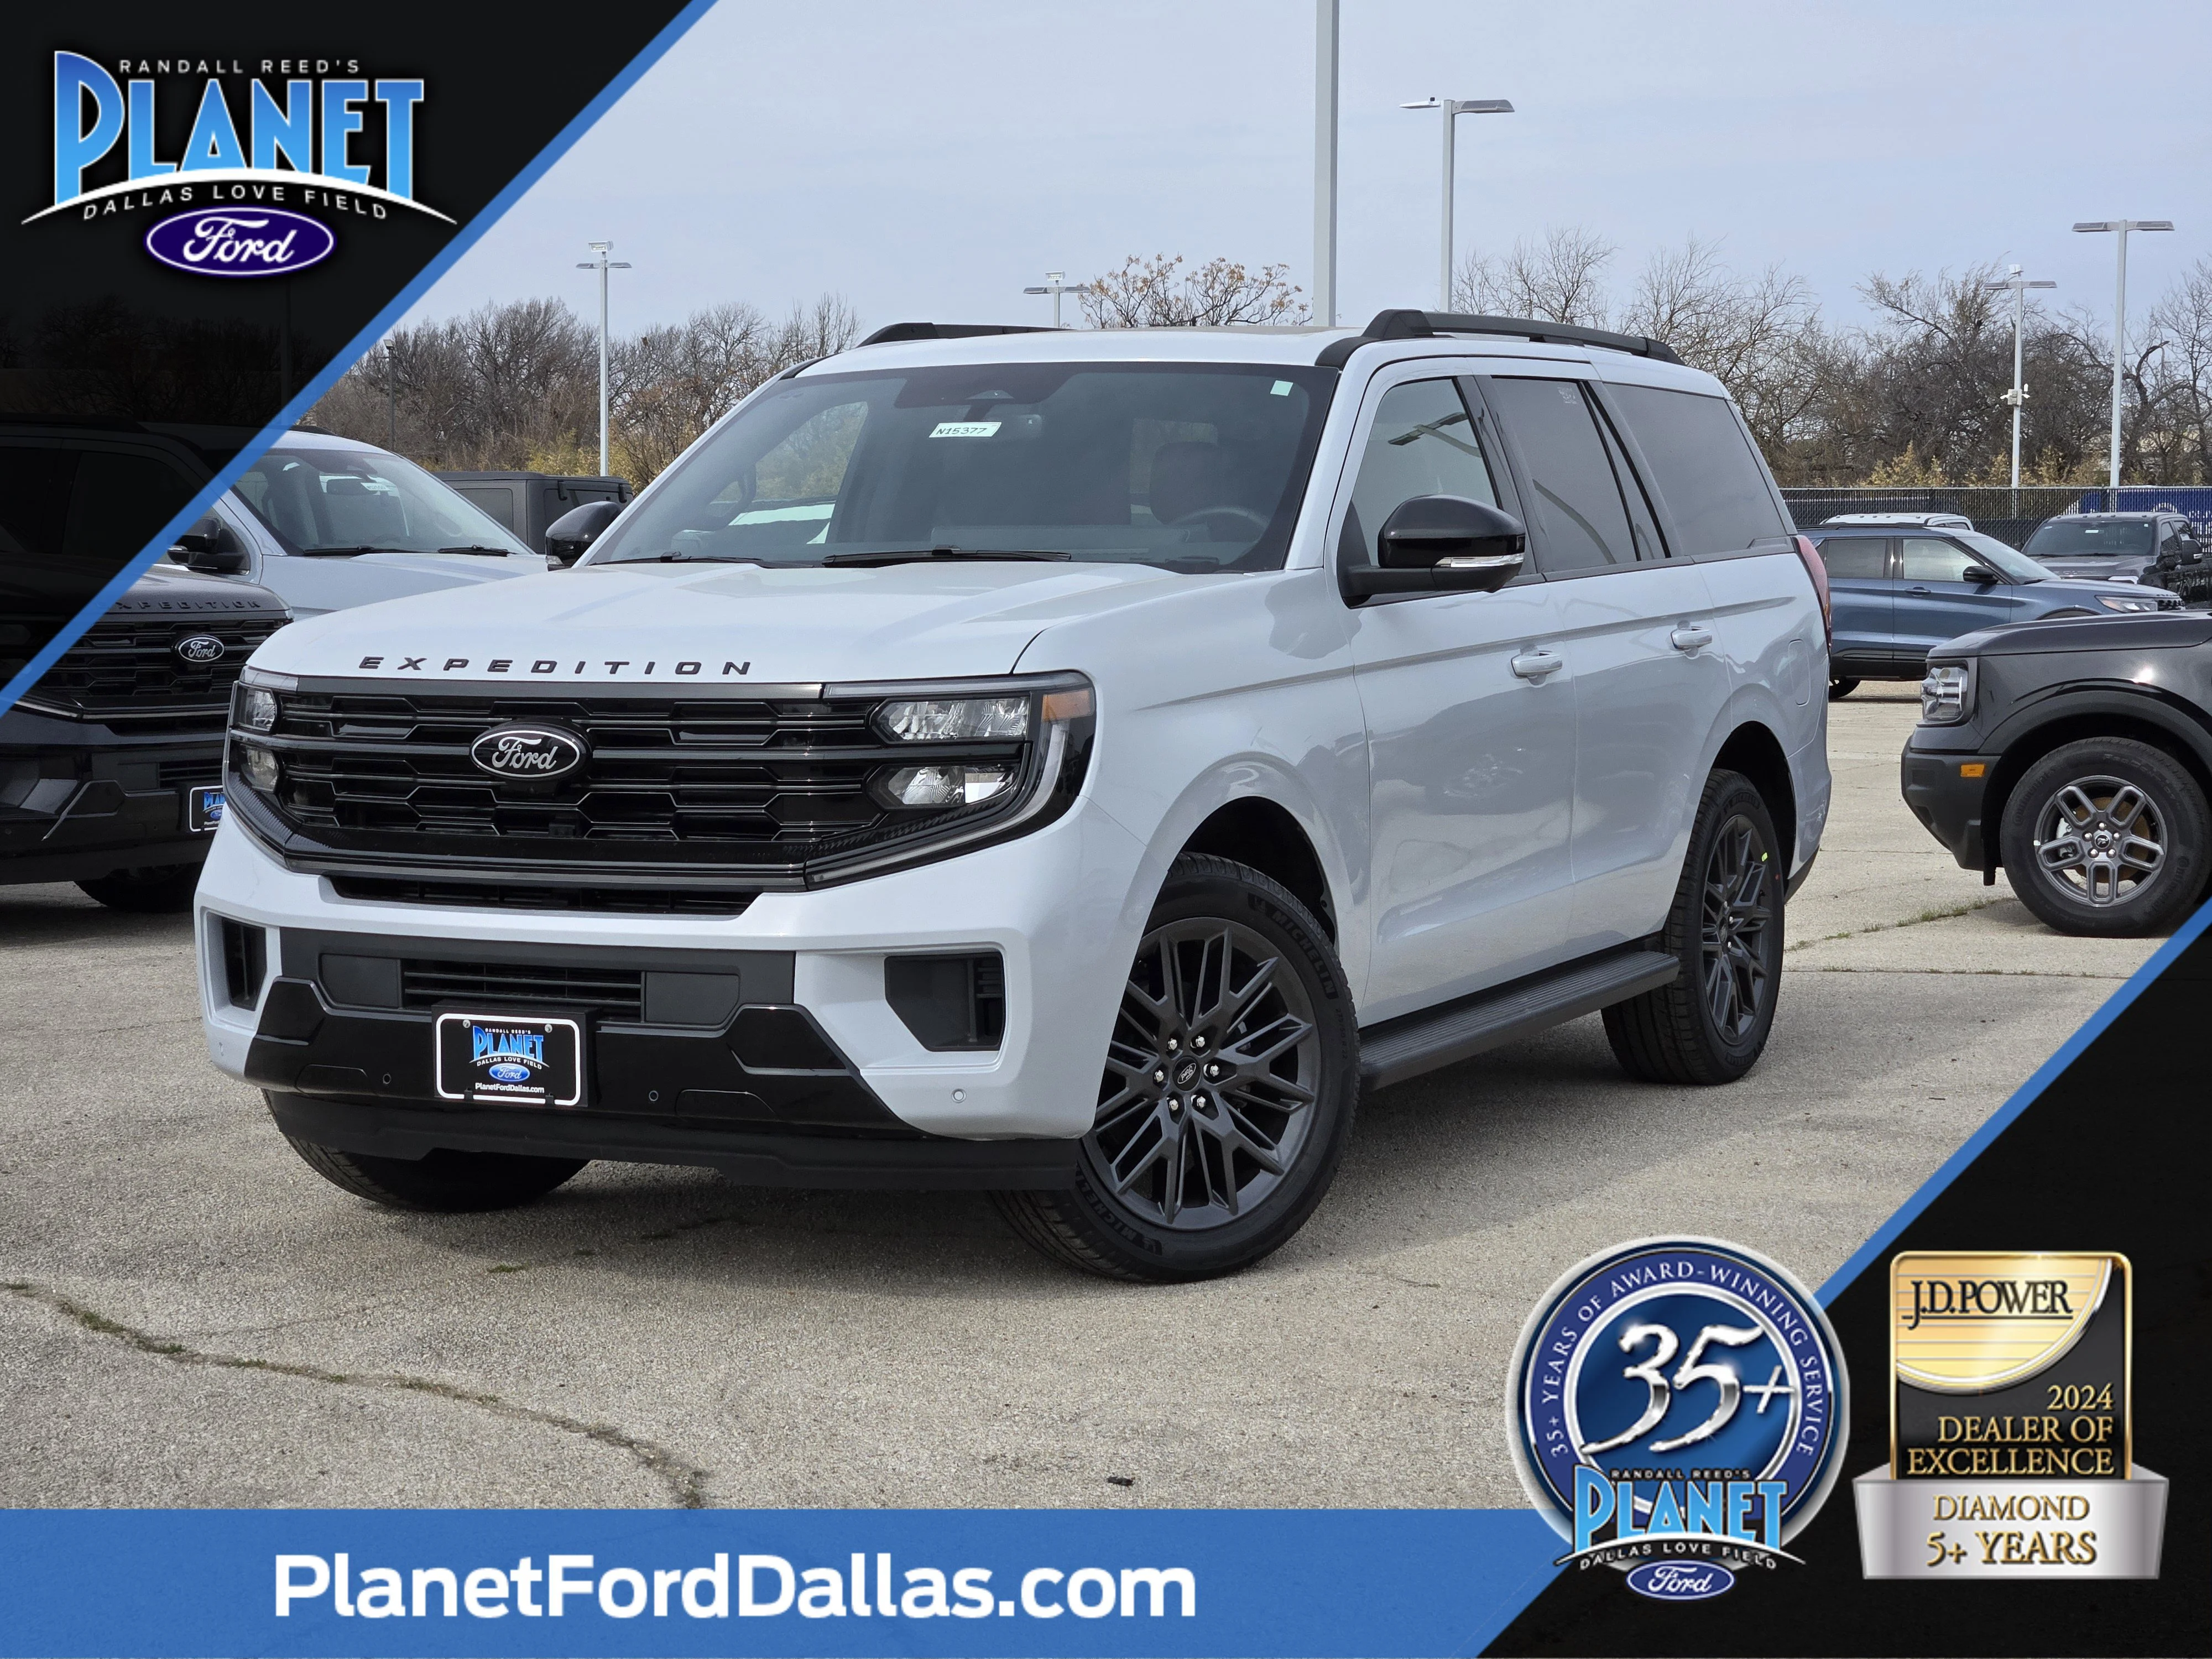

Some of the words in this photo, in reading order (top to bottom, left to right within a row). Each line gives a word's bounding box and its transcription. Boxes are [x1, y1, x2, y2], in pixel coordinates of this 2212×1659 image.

[936, 427, 988, 435] N15377
[115, 600, 262, 609] XPEDITION
[188, 640, 216, 658] Ford
[358, 656, 751, 675] EXPEDITION
[491, 736, 558, 770] Ford
[1271, 908, 1337, 997] MICHELIN
[473, 1025, 544, 1062] PLANET
[477, 1057, 502, 1067] DALLAS
[524, 1060, 542, 1070] FIELD
[497, 1067, 522, 1079] Ford
[475, 1082, 545, 1094] PlanetFordDallas.com
